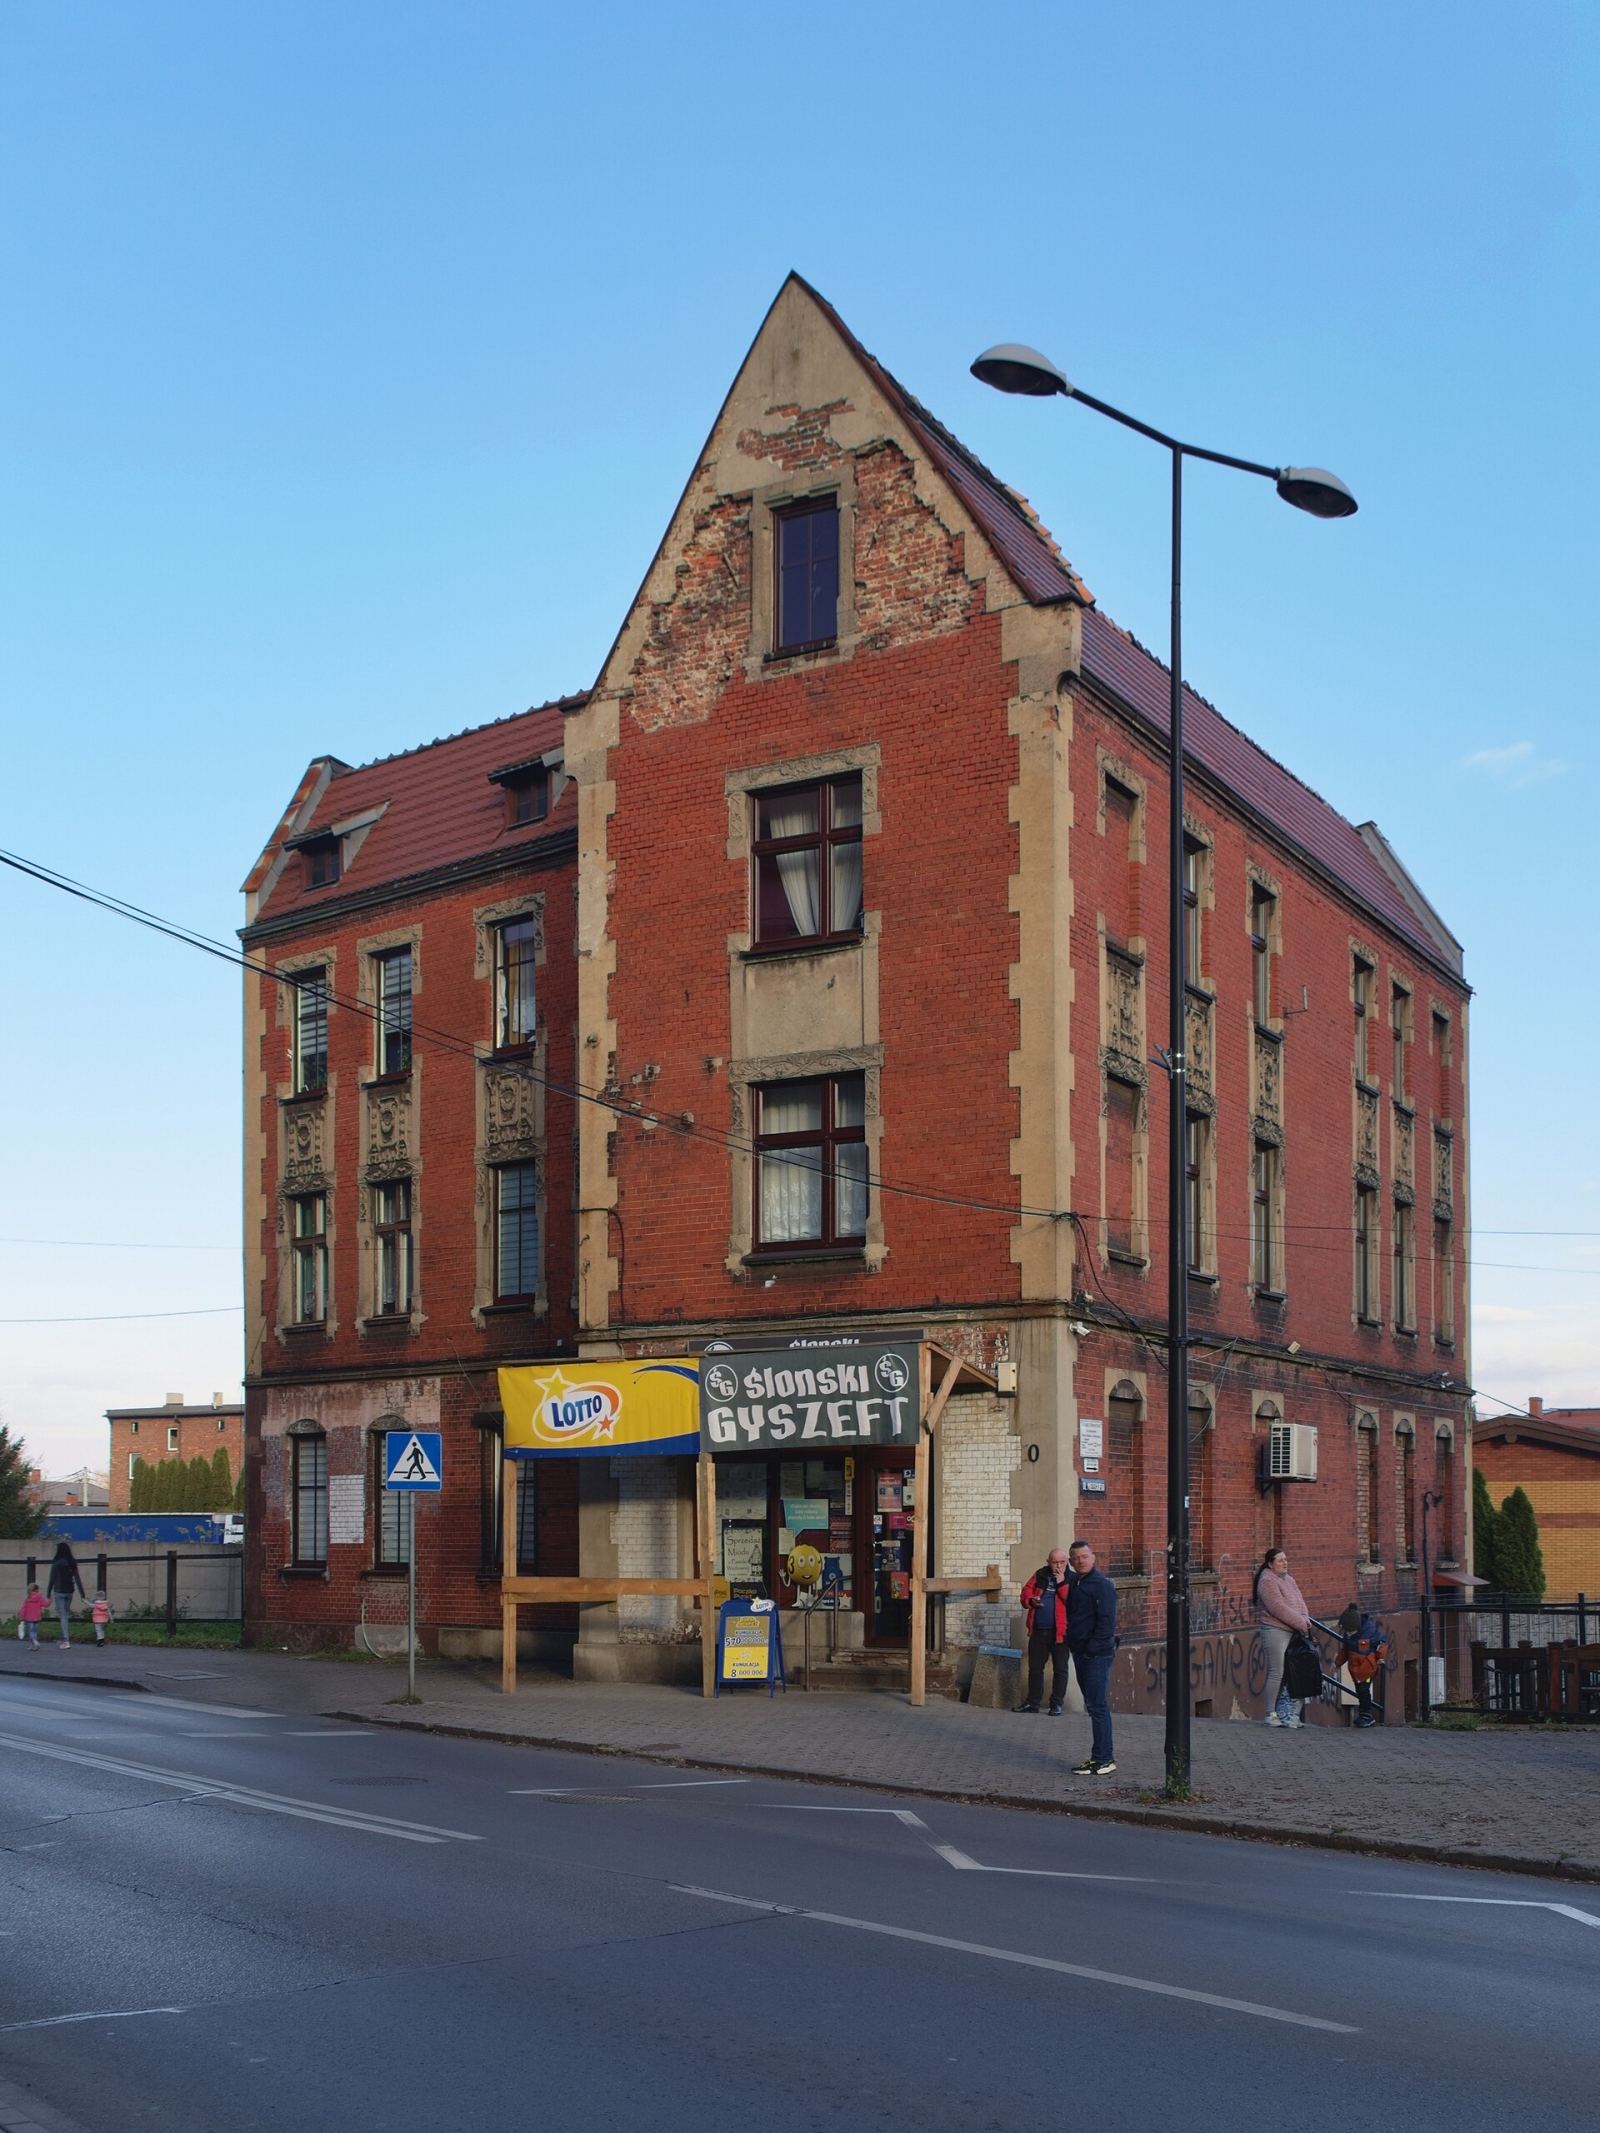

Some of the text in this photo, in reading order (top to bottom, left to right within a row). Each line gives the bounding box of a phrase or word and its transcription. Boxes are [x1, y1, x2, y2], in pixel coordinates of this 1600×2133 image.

[551, 1395, 603, 1428] LOTTO
[707, 1396, 909, 1443] GYSZEFT
[730, 1669, 737, 1677] 8
